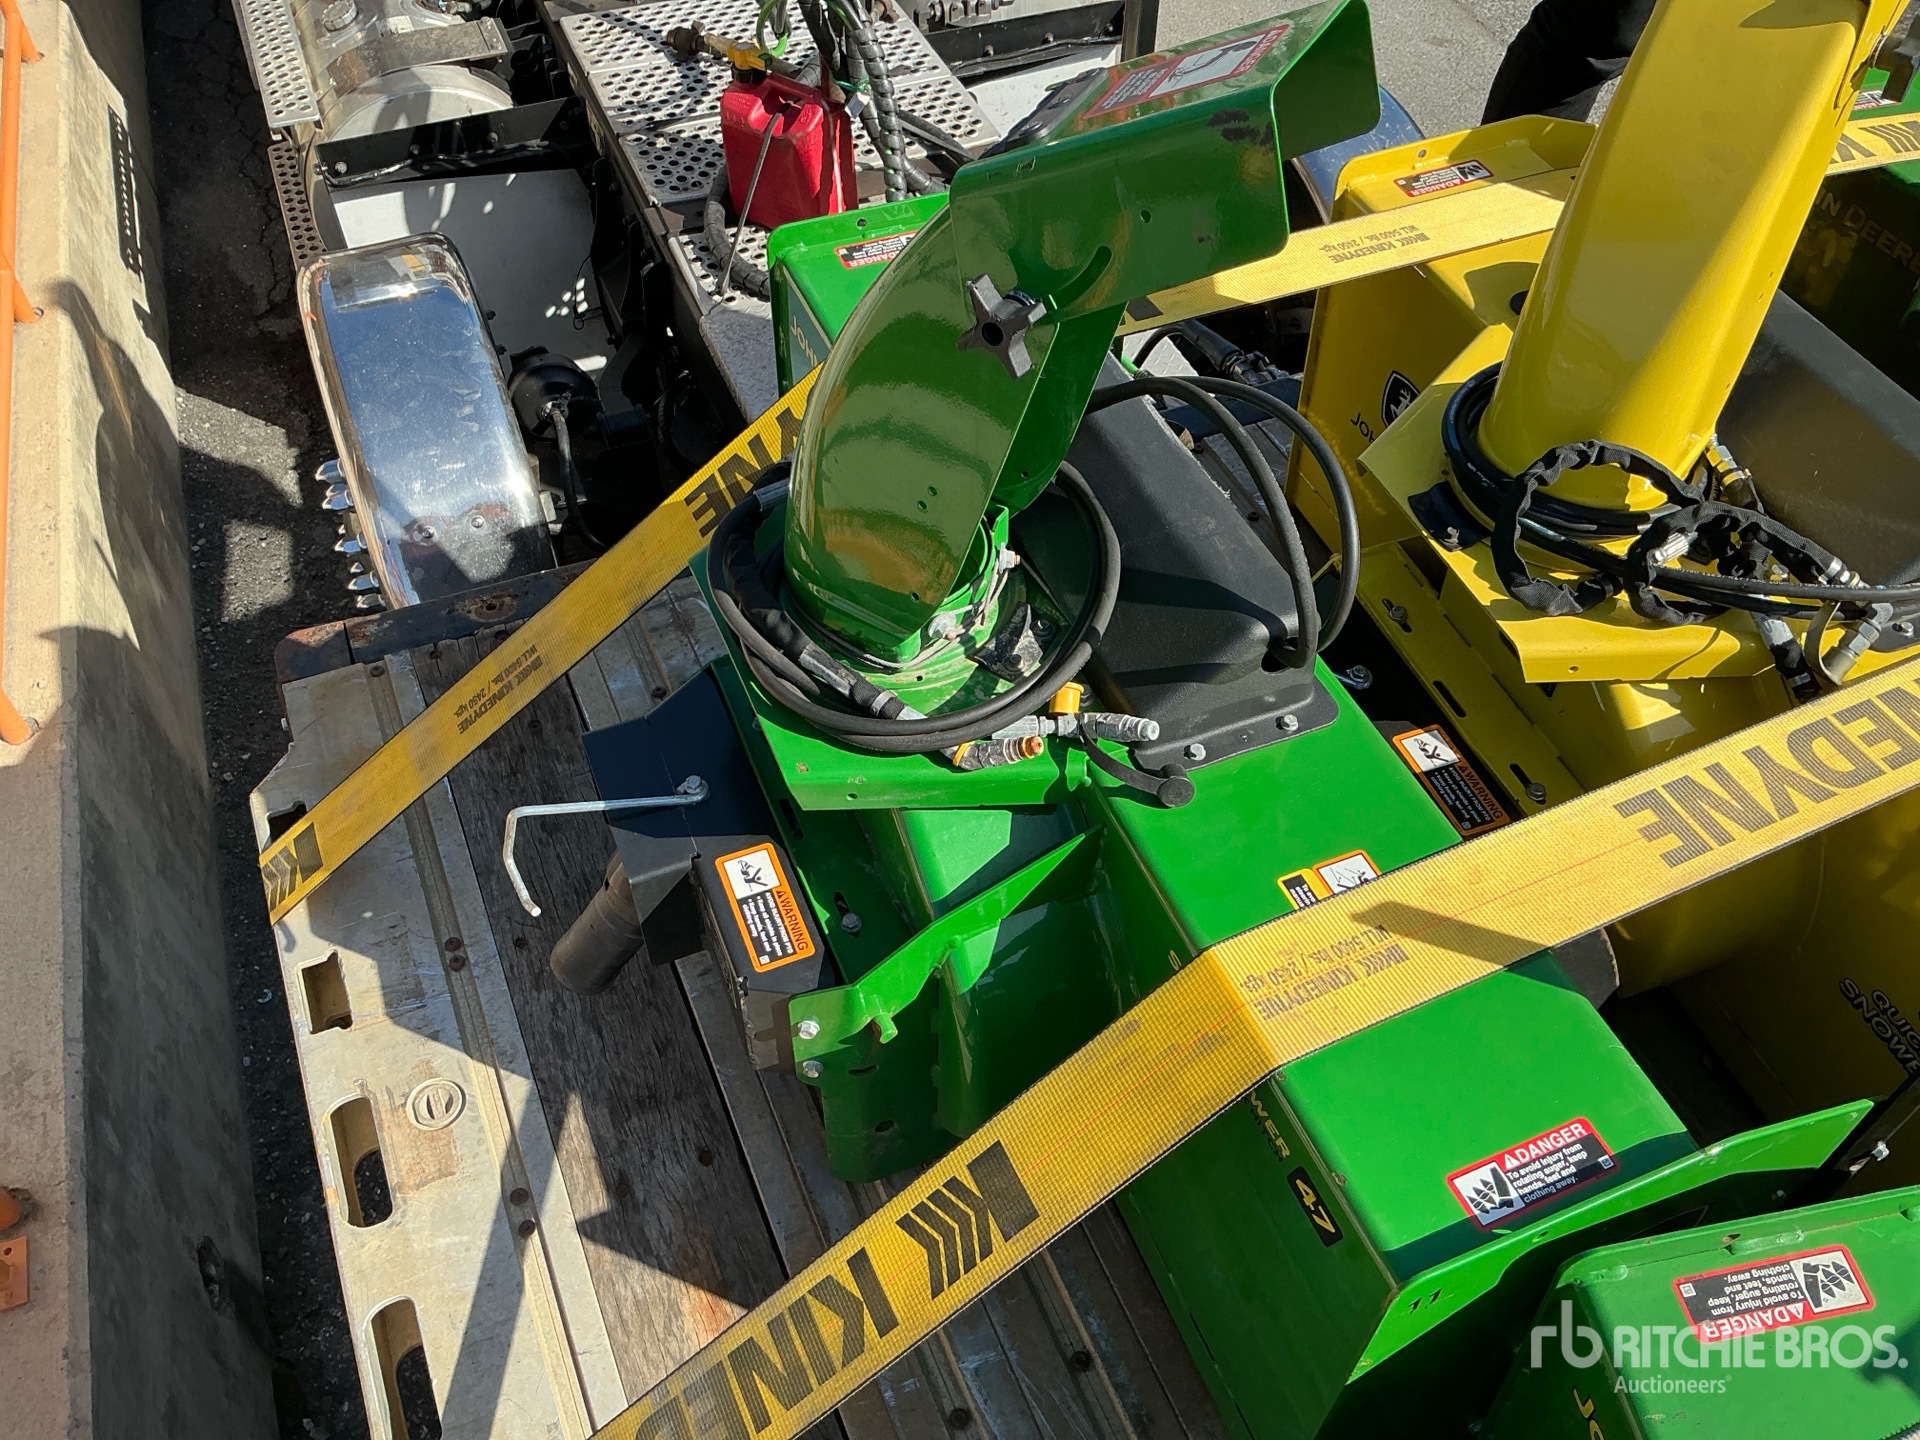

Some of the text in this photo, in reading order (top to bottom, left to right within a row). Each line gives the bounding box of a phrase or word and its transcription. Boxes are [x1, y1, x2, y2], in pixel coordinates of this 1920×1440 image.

[1409, 181, 1454, 195] DANGER
[848, 252, 897, 266] DANGER
[1328, 240, 1396, 263] KINEDYNE
[457, 680, 513, 734] KINEDYNE
[1463, 771, 1504, 819] WARNING
[748, 901, 757, 914] Keep
[762, 941, 771, 951] and
[756, 899, 766, 912] Keep
[772, 941, 783, 956] place
[764, 891, 793, 953] AVOID INJURY FROM PTO
[779, 896, 809, 951] WARNING
[1360, 923, 1391, 946] WLL
[1329, 934, 1365, 960] 5400
[1266, 961, 1303, 987] 2450
[1253, 963, 1358, 1021] KINEDYNE
[1514, 1122, 1587, 1163] DANGER
[1506, 1142, 1582, 1181] To avoid injury from
[1512, 1149, 1588, 1189] rotating auger, keep
[1543, 1171, 1561, 1183] feet
[1559, 1164, 1576, 1176] and
[1522, 1174, 1579, 1204] clothing away.
[1295, 1179, 1335, 1233] 47
[1722, 1262, 1791, 1283] clothing away.
[1723, 1272, 1795, 1294] hands, feet and
[1706, 1280, 1799, 1307] rotating auger, keep
[1710, 1290, 1804, 1316] To avoid injury from
[1701, 1305, 1790, 1338] DANGER
